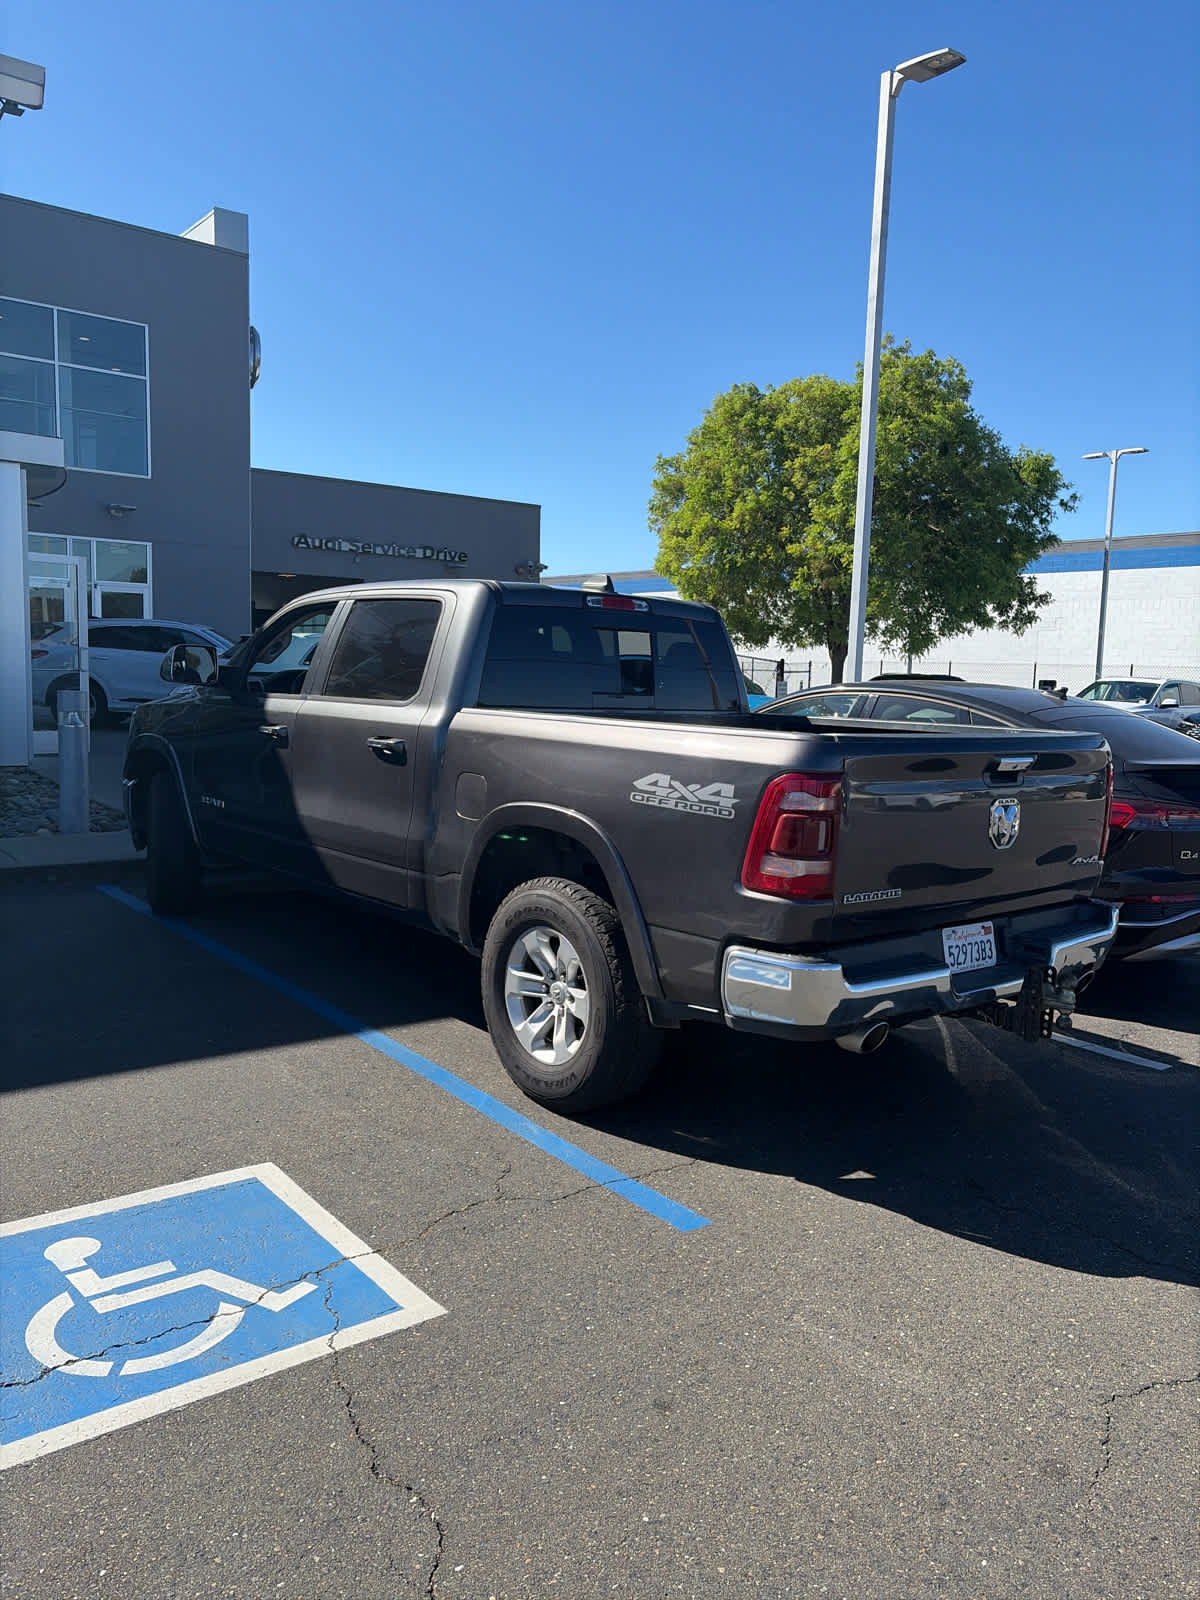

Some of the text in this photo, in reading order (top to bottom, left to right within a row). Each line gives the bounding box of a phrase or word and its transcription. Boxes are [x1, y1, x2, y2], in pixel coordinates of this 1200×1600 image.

[348, 540, 416, 559] Service
[421, 545, 469, 562] Drive
[631, 792, 735, 818] OFF ROAD
[843, 888, 902, 904] LARAMIE
[948, 939, 993, 967] 52973B3
